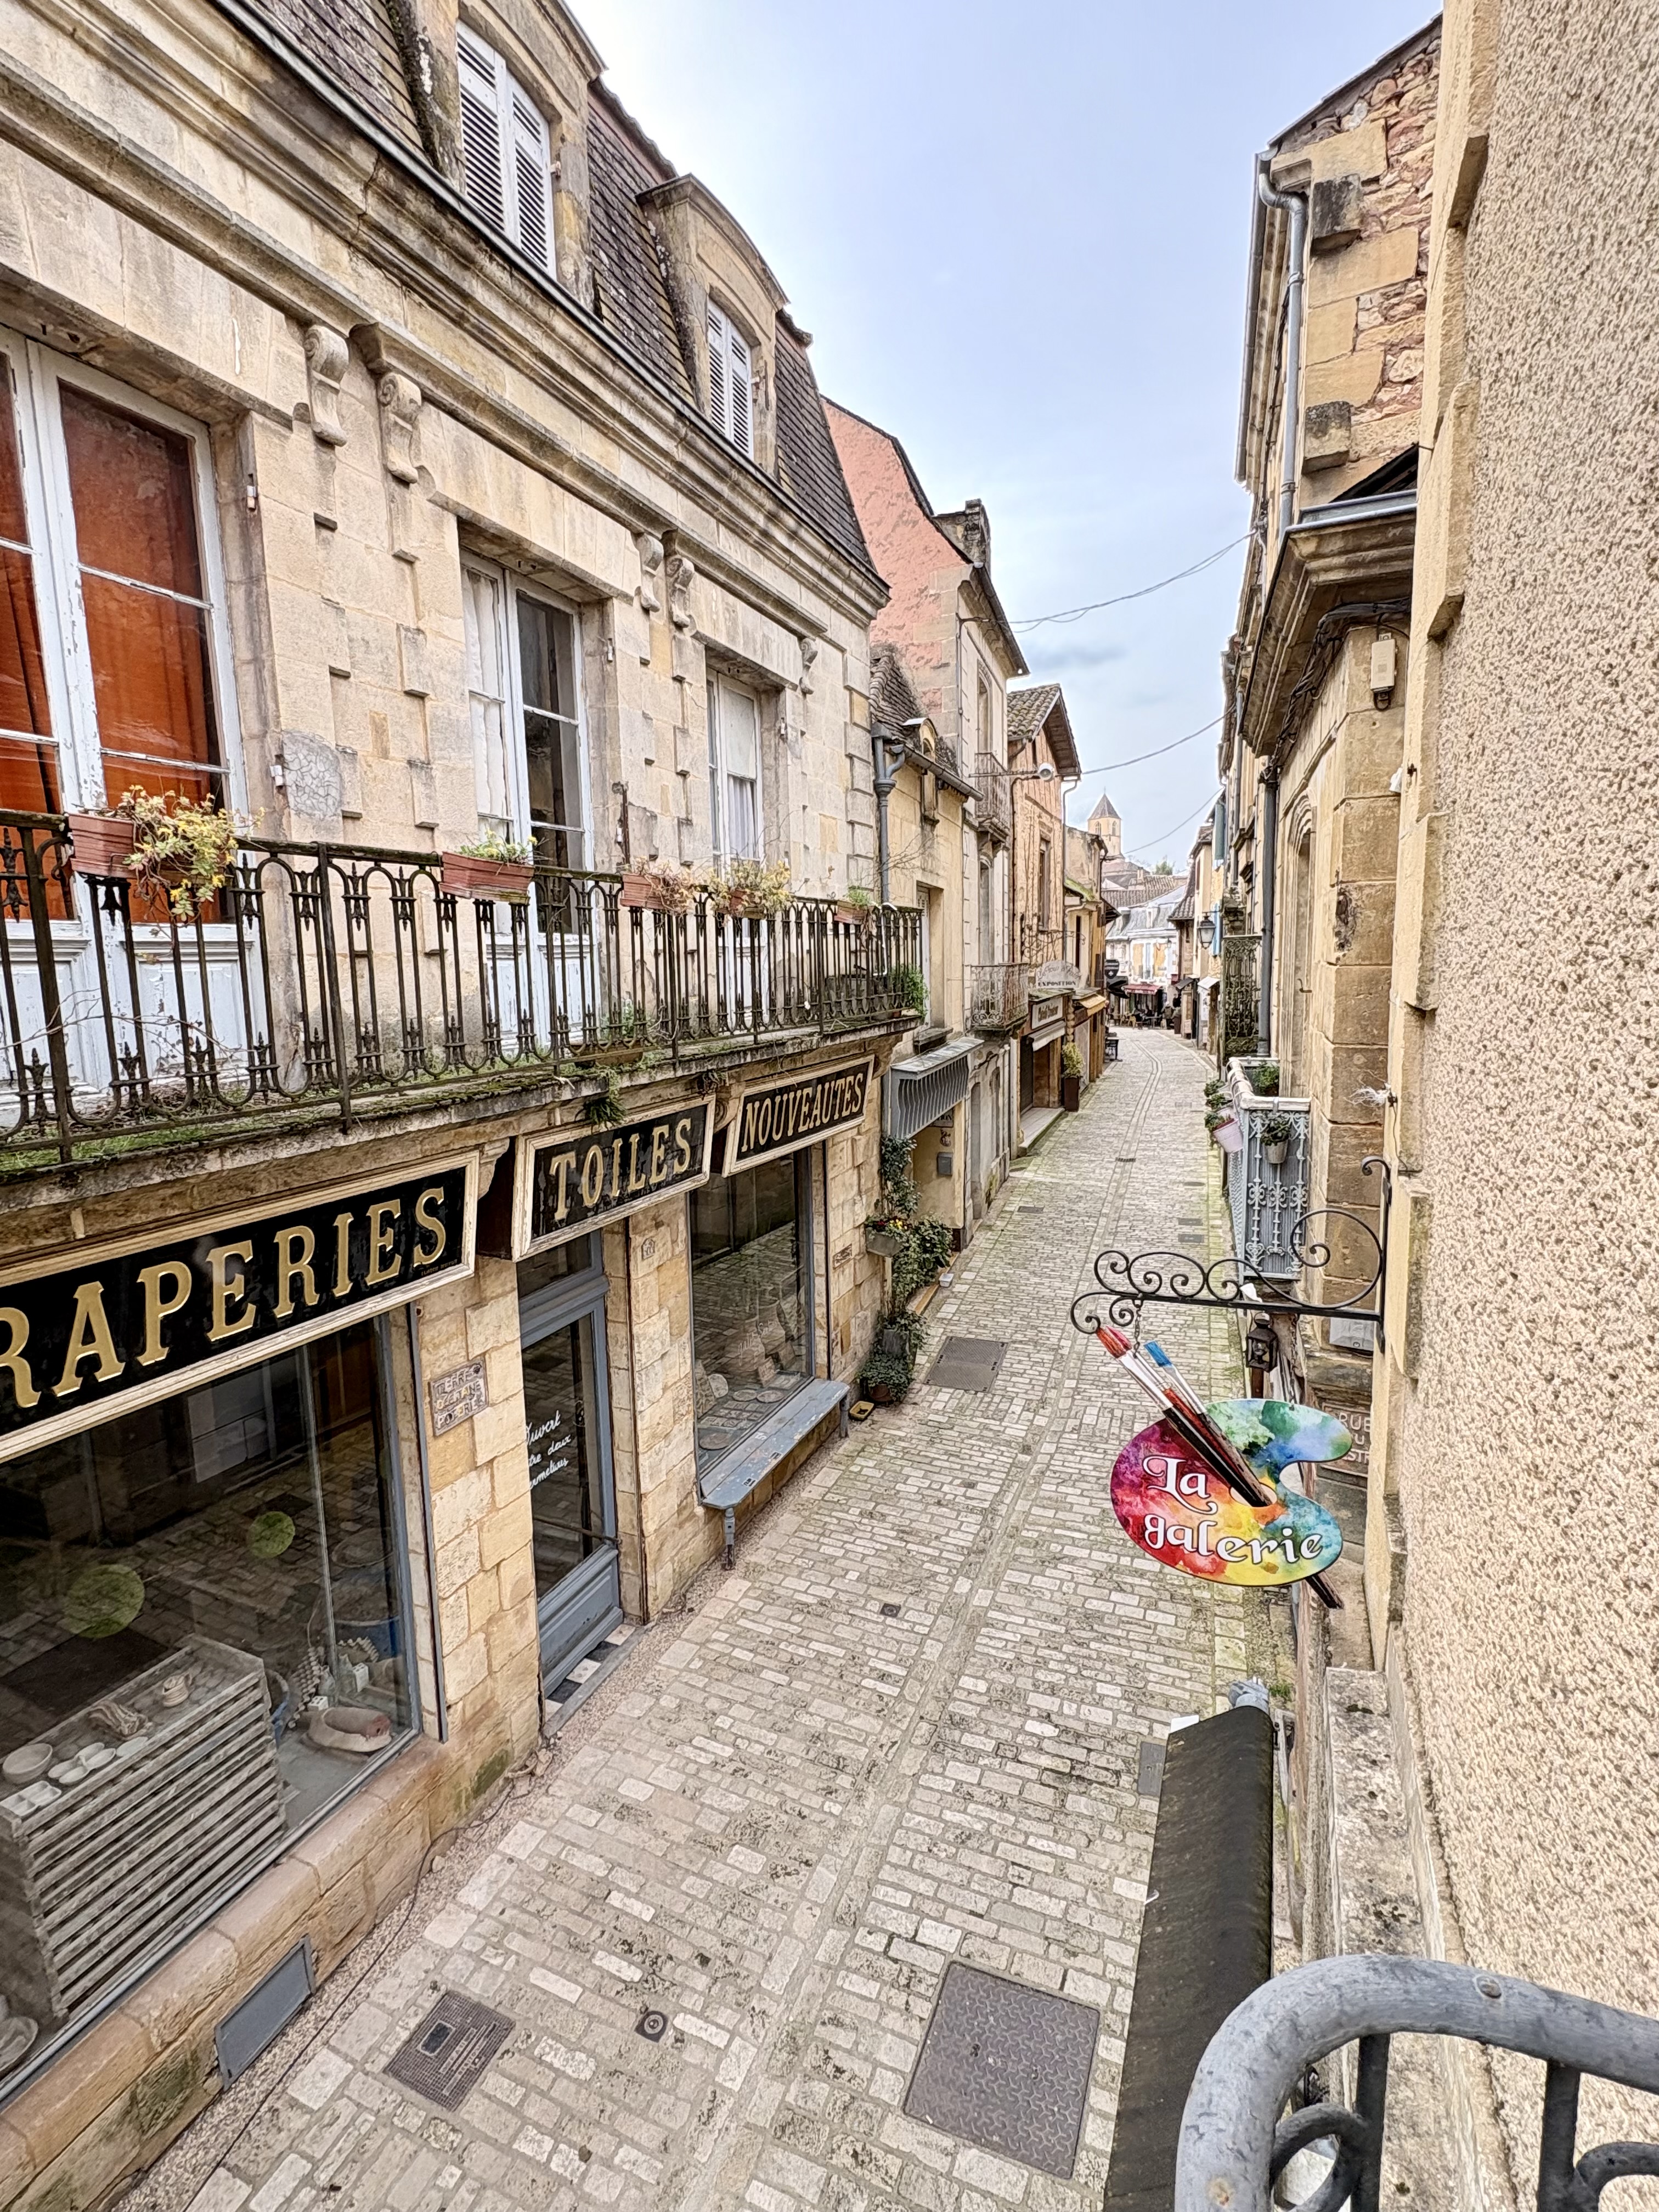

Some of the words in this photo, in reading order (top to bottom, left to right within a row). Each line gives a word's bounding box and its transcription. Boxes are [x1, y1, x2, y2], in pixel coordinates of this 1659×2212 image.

[741, 1074, 864, 1152] NOUVEAUTES
[549, 1118, 691, 1220] TOILES
[1143, 1455, 1218, 1515] La
